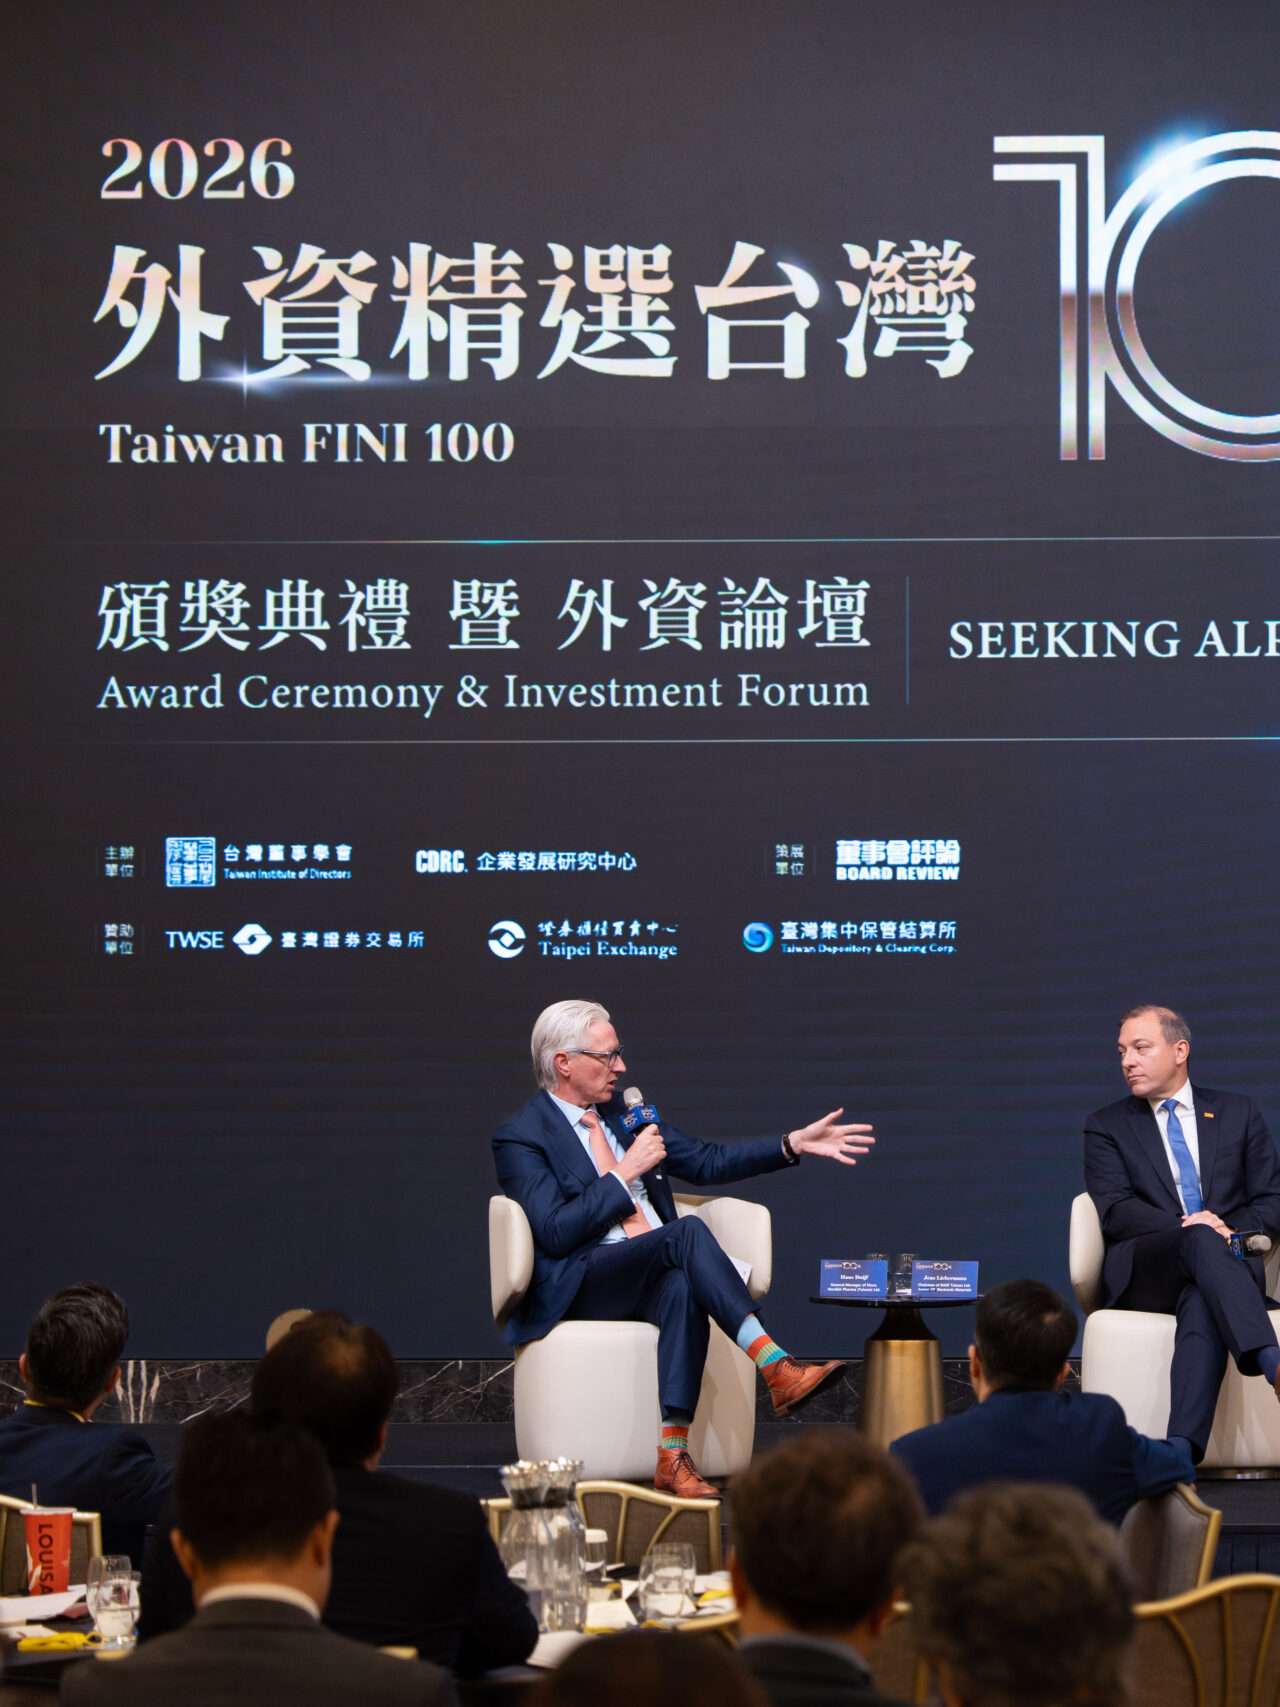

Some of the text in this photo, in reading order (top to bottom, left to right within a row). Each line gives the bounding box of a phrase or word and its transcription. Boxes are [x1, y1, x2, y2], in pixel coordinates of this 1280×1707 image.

[101, 138, 294, 199] 2026
[94, 240, 977, 381] 外資精選台灣
[99, 423, 514, 463] Taiwan FINI 100
[97, 576, 870, 652] 頒獎典禮 暨 外資論壇
[950, 621, 1180, 658] SEEKING
[97, 673, 869, 718] Award Ceremony & Investment Forum
[223, 844, 353, 862] 台灣董事學會
[477, 851, 637, 871] 企業發展研究中心
[836, 840, 961, 865] 董事會評論
[223, 868, 352, 880] Taiwan Institute of Directors
[836, 866, 960, 880] BOARD REVIEW
[165, 931, 224, 949] TWSE
[781, 921, 956, 940] 臺灣集中保管結算所
[538, 941, 678, 960] Taipei Exchange
[781, 943, 816, 953] Taiwan
[885, 943, 927, 955] Clearing
